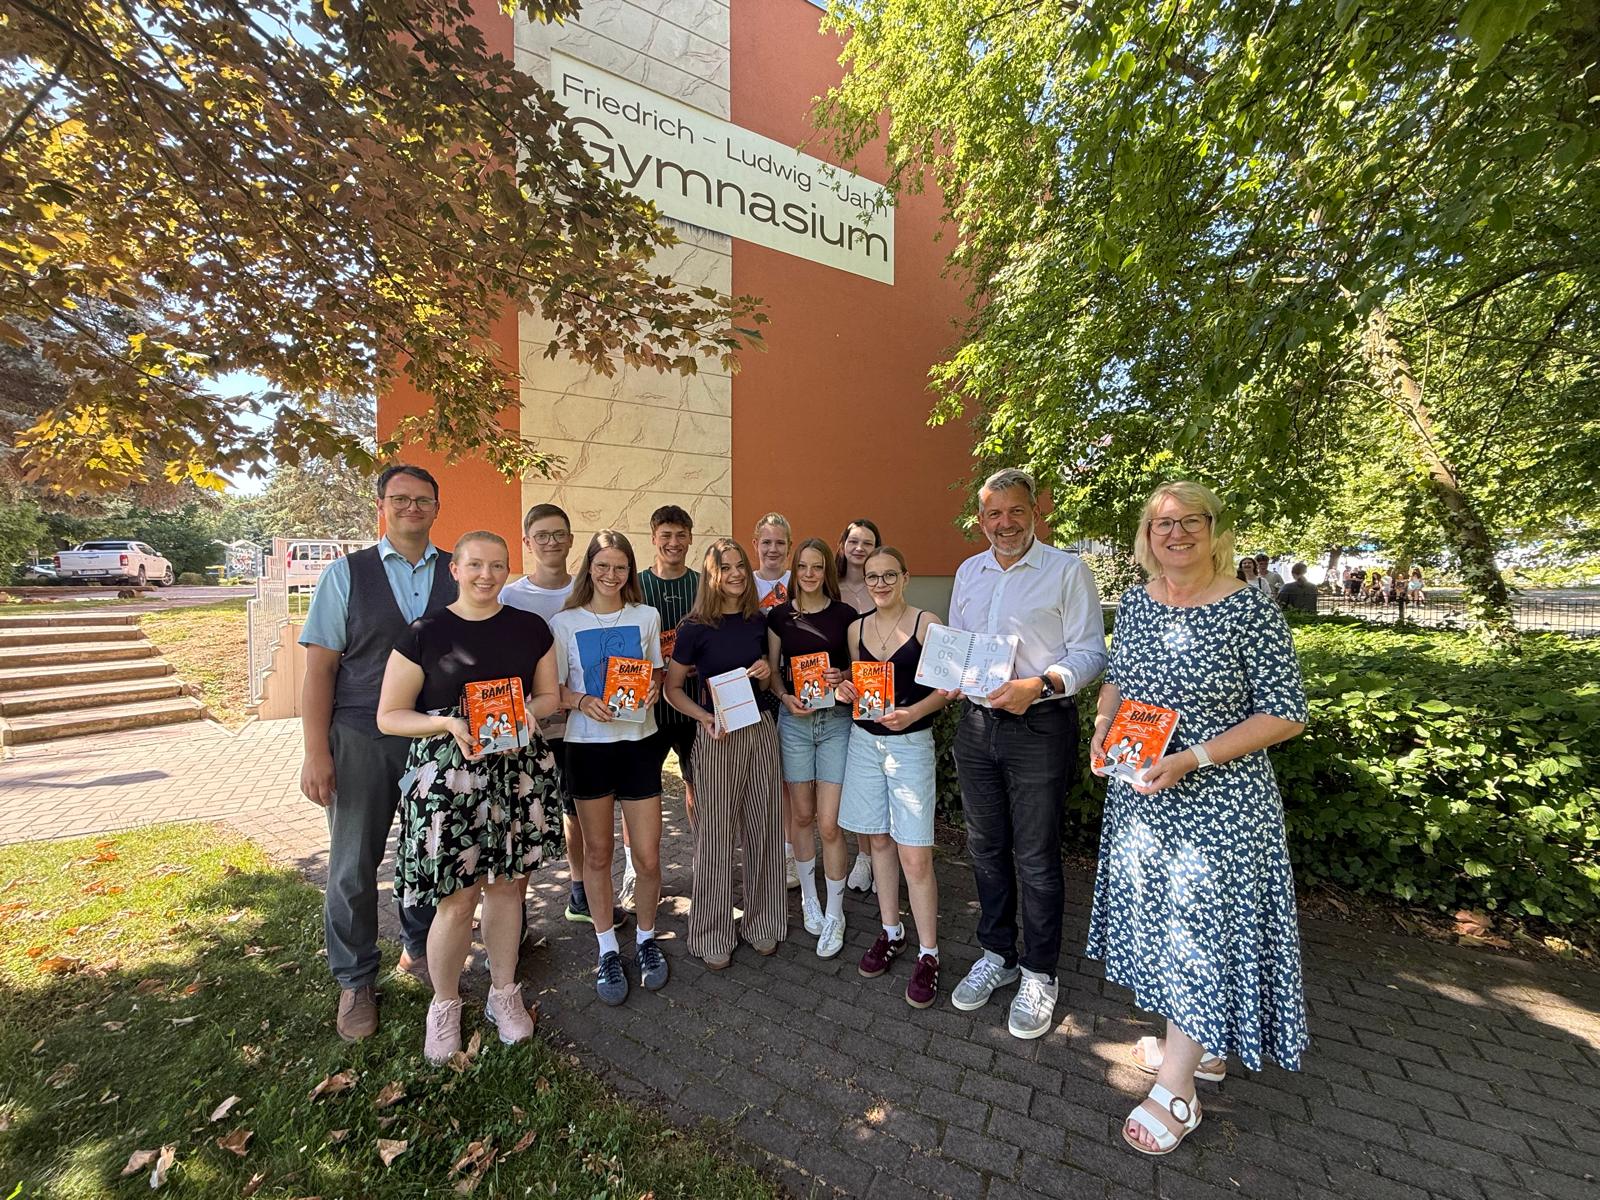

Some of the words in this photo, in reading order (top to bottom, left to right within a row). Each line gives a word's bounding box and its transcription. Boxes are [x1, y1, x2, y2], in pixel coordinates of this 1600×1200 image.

[563, 73, 695, 144] Friedrich
[726, 137, 812, 193] Ludwig
[836, 184, 888, 218] Jahn
[941, 635, 958, 646] 07
[937, 650, 953, 661] 08
[619, 664, 643, 674] BAM!
[800, 657, 820, 670] BAM!
[933, 666, 949, 678] 09
[1130, 710, 1163, 725] BAM!
